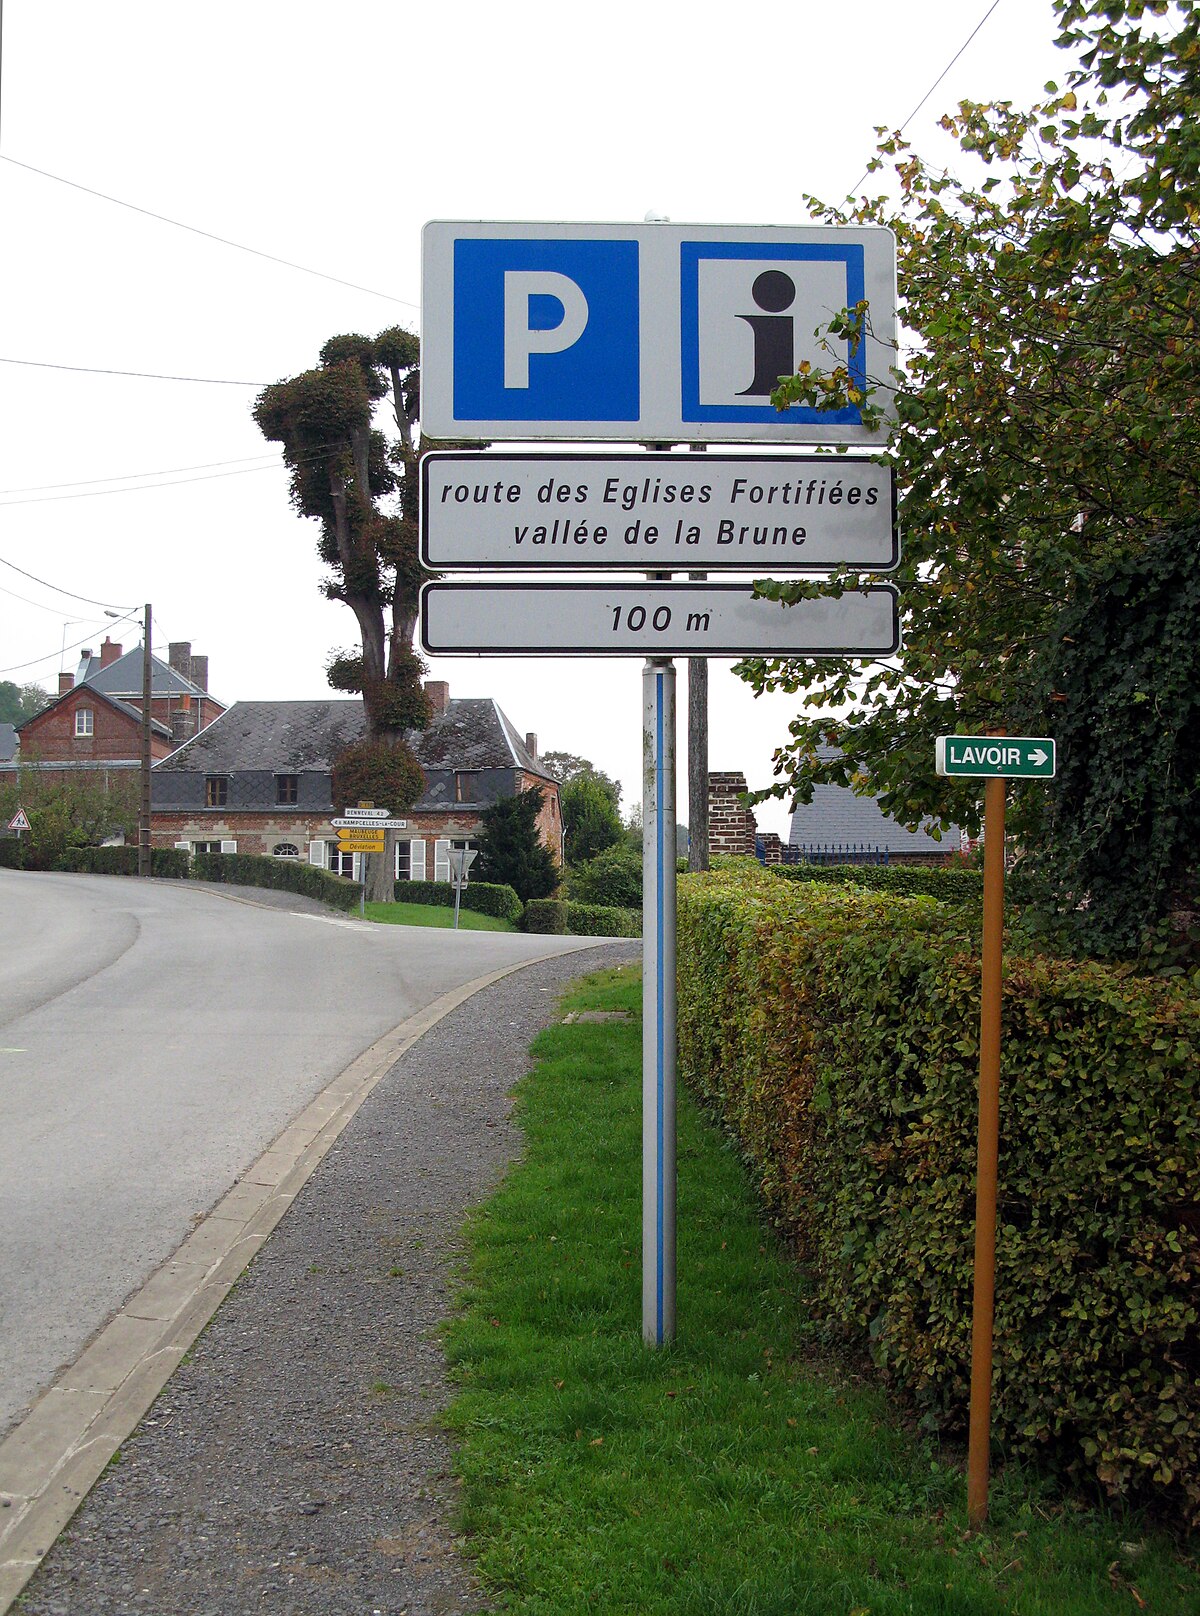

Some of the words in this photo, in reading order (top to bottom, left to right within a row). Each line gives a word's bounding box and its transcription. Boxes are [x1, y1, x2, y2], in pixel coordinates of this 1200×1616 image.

[504, 270, 589, 389] P
[441, 481, 522, 503] route
[537, 478, 589, 503] des
[602, 478, 712, 511] Eglises
[730, 478, 879, 505] Fortifiées
[514, 519, 608, 545] vallée
[624, 519, 659, 545] de
[674, 519, 701, 545] la
[716, 519, 807, 545] Brune
[612, 605, 672, 632] 100
[686, 613, 710, 631] m
[950, 746, 1021, 765] LAVOIR
